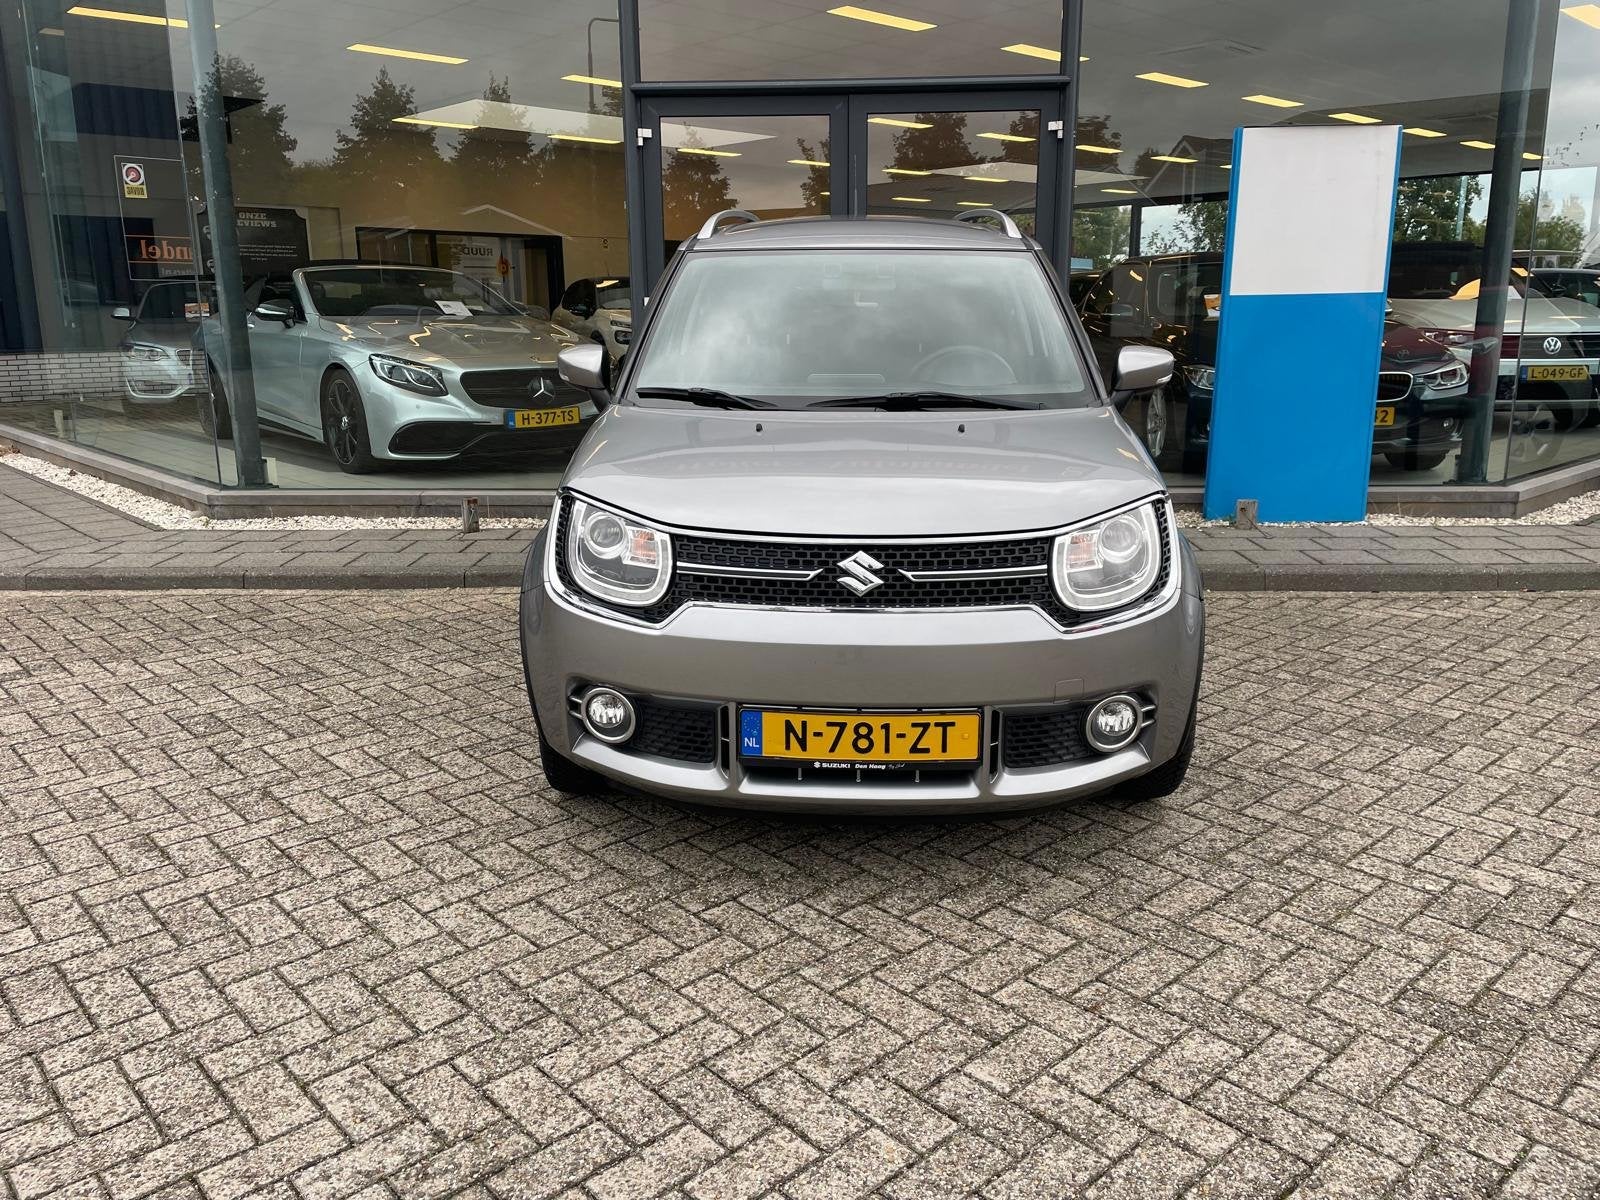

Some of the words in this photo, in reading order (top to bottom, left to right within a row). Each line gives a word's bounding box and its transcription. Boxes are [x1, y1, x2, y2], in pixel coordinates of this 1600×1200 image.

[236, 219, 277, 228] EVIEWS
[1531, 367, 1584, 379] L-049-GF
[521, 409, 574, 426] H-377-TS
[744, 737, 760, 748] NL
[784, 719, 956, 755] N-781-ZT
